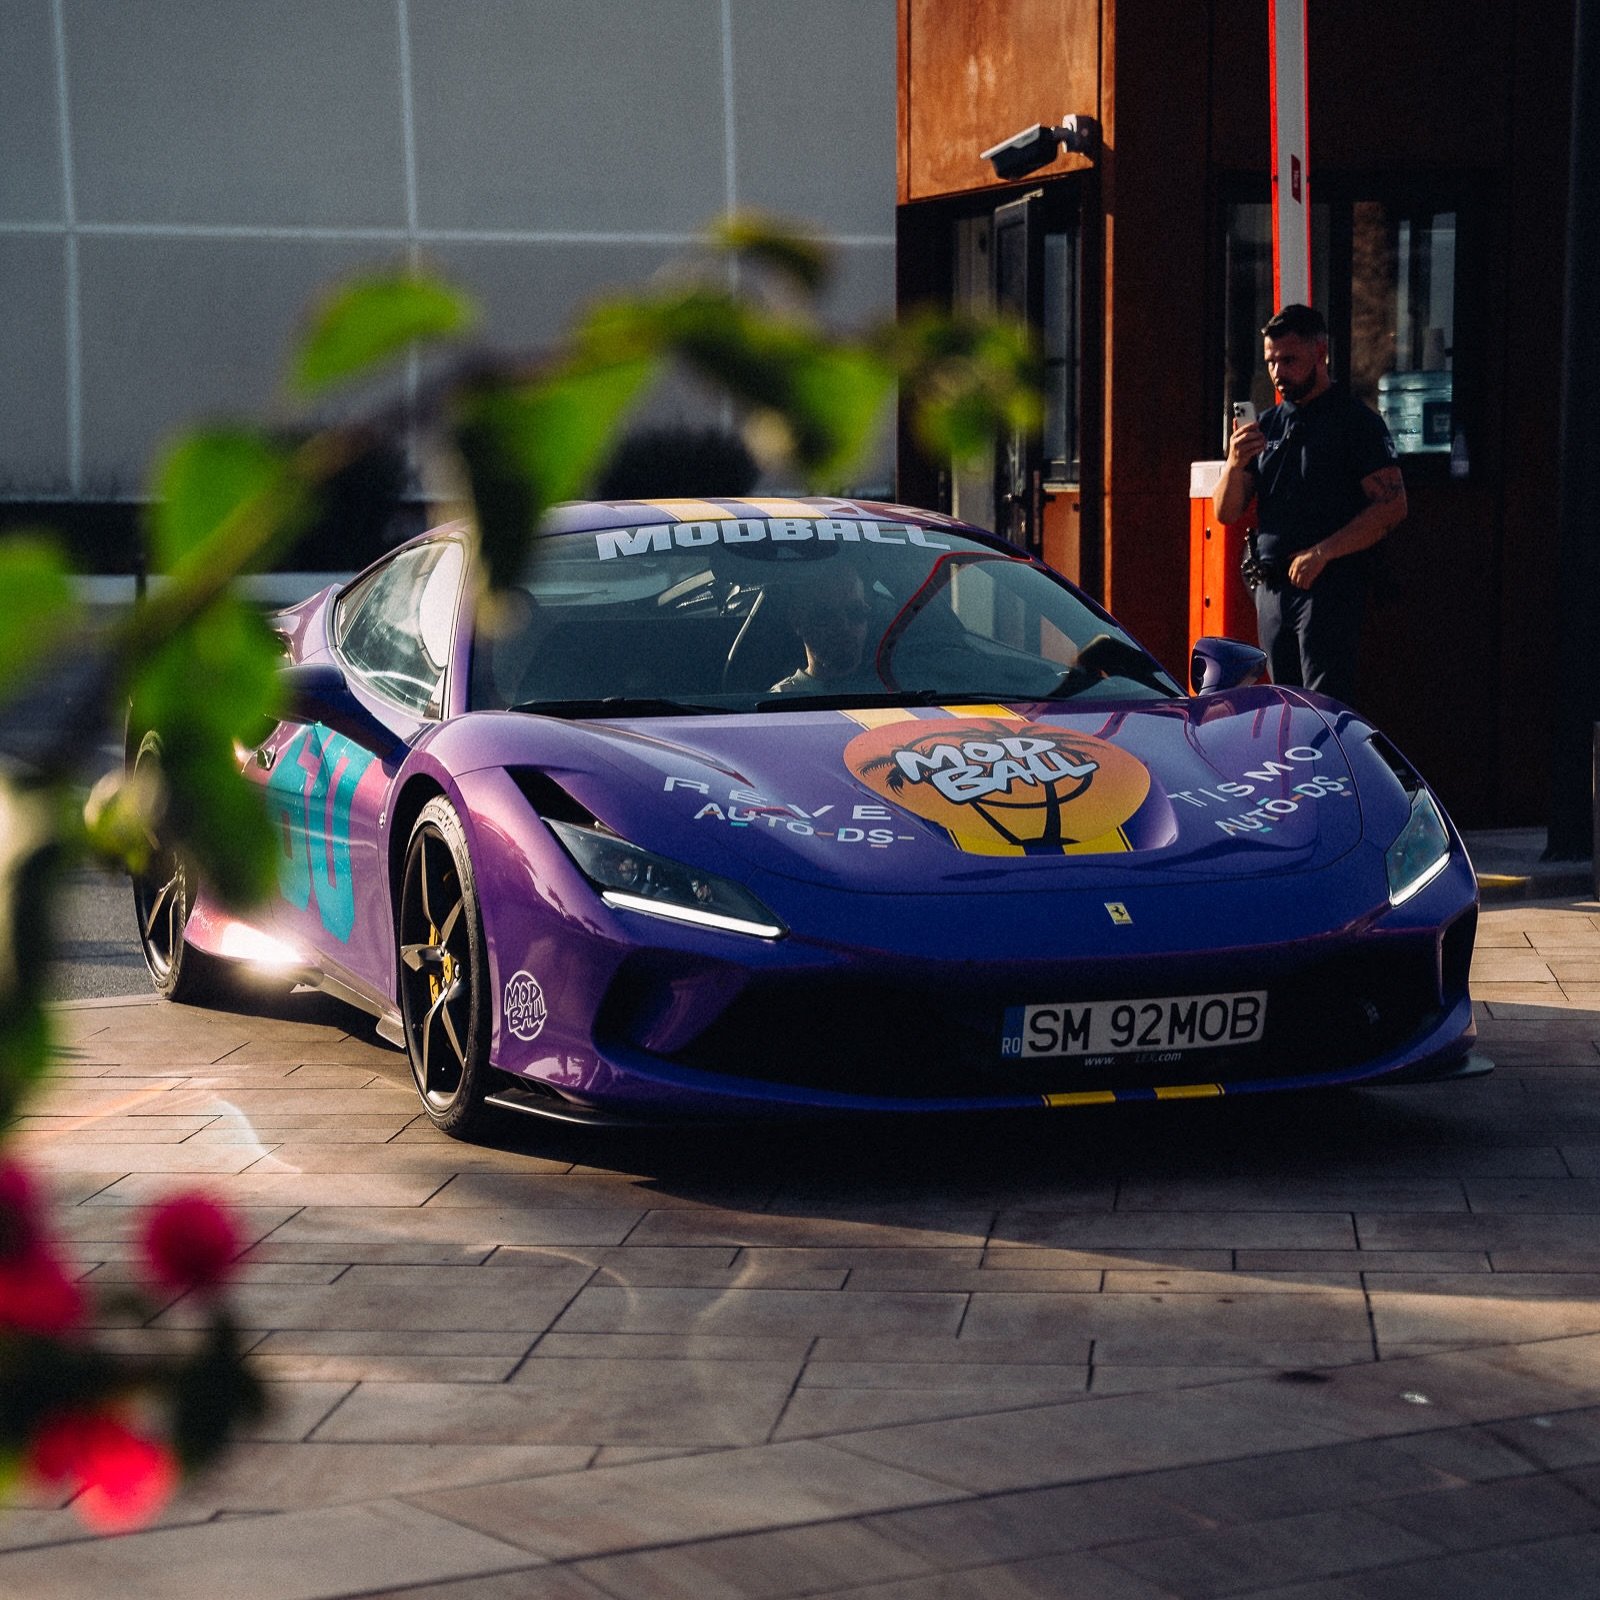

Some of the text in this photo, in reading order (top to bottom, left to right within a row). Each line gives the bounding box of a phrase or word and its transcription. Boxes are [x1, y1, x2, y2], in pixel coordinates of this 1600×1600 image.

[595, 518, 951, 561] MODBALL
[894, 737, 1056, 781] MOD
[931, 750, 1100, 801] BALL
[1167, 746, 1323, 808] TISMO
[663, 776, 892, 821] REVE
[504, 981, 541, 1015] MOD
[508, 998, 547, 1033] BALL
[1002, 1037, 1021, 1054] RO
[1028, 1008, 1092, 1053] SM
